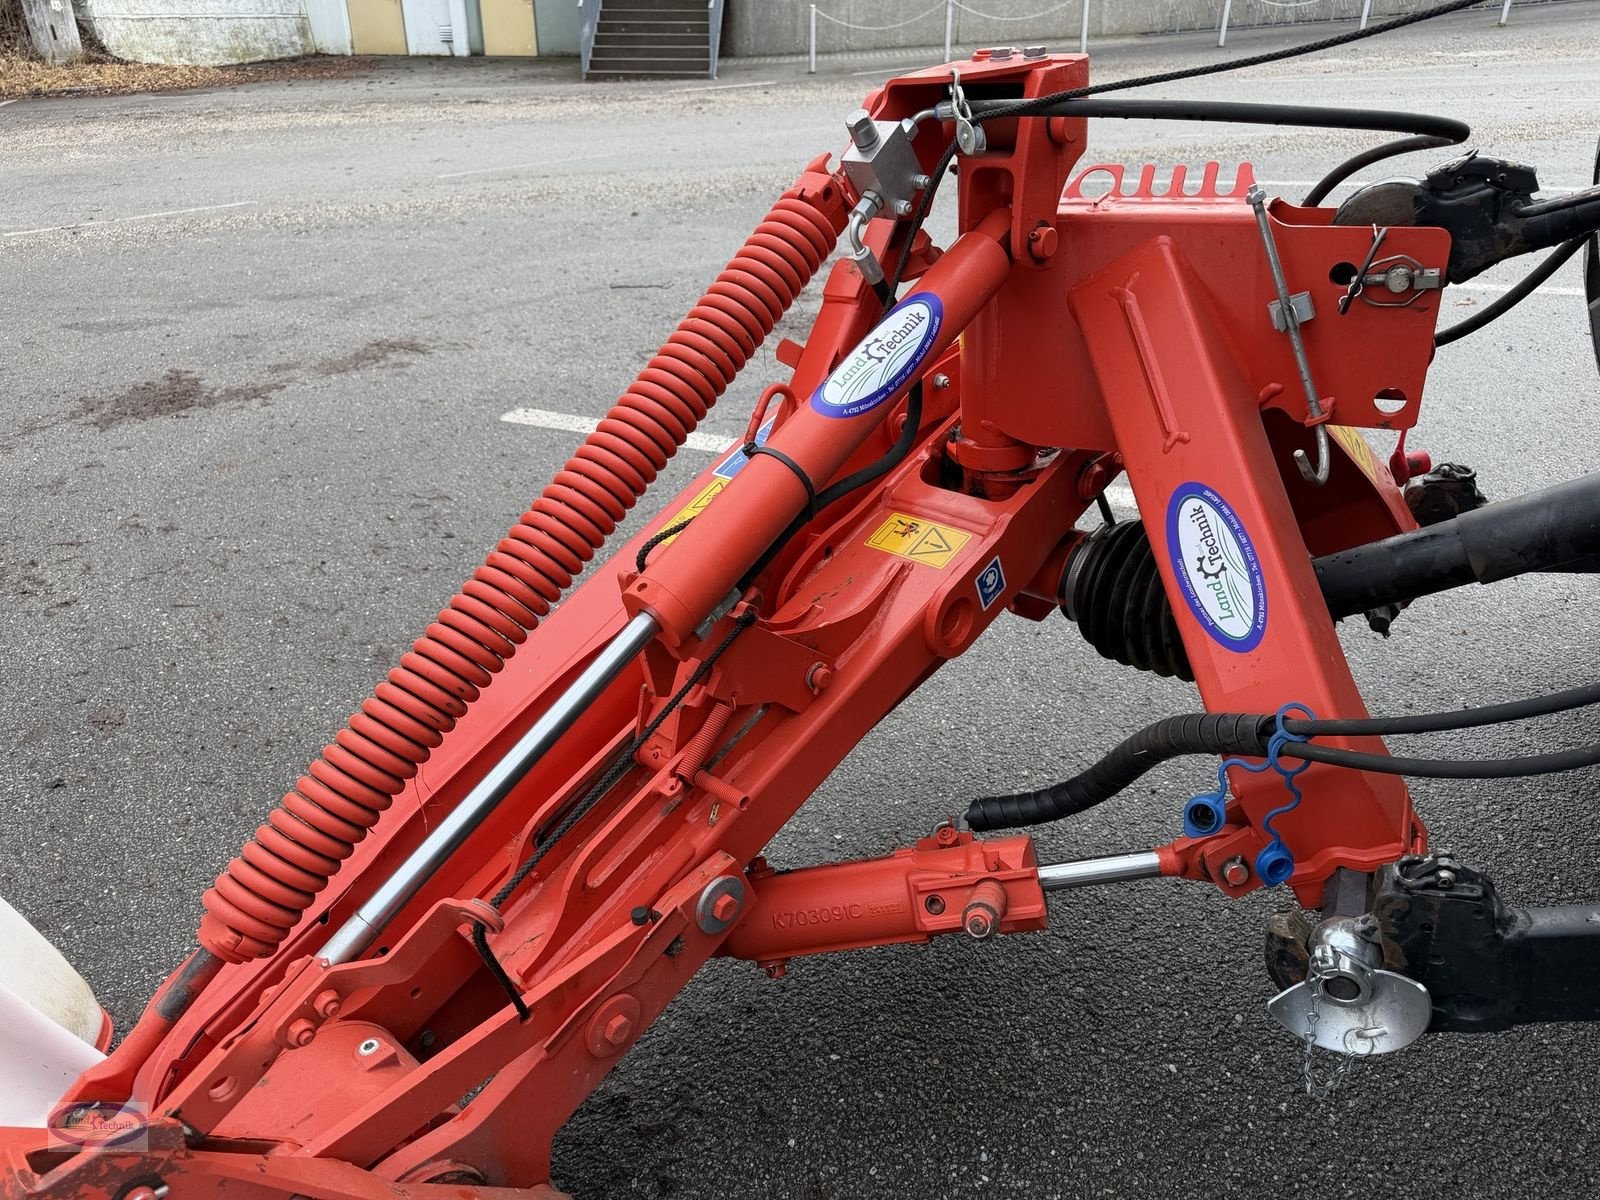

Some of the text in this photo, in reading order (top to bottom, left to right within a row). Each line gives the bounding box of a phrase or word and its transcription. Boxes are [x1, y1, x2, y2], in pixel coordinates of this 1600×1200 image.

[876, 311, 925, 356] Technik
[832, 356, 868, 388] Land
[1190, 505, 1223, 566] Technik
[1207, 580, 1234, 621] Land
